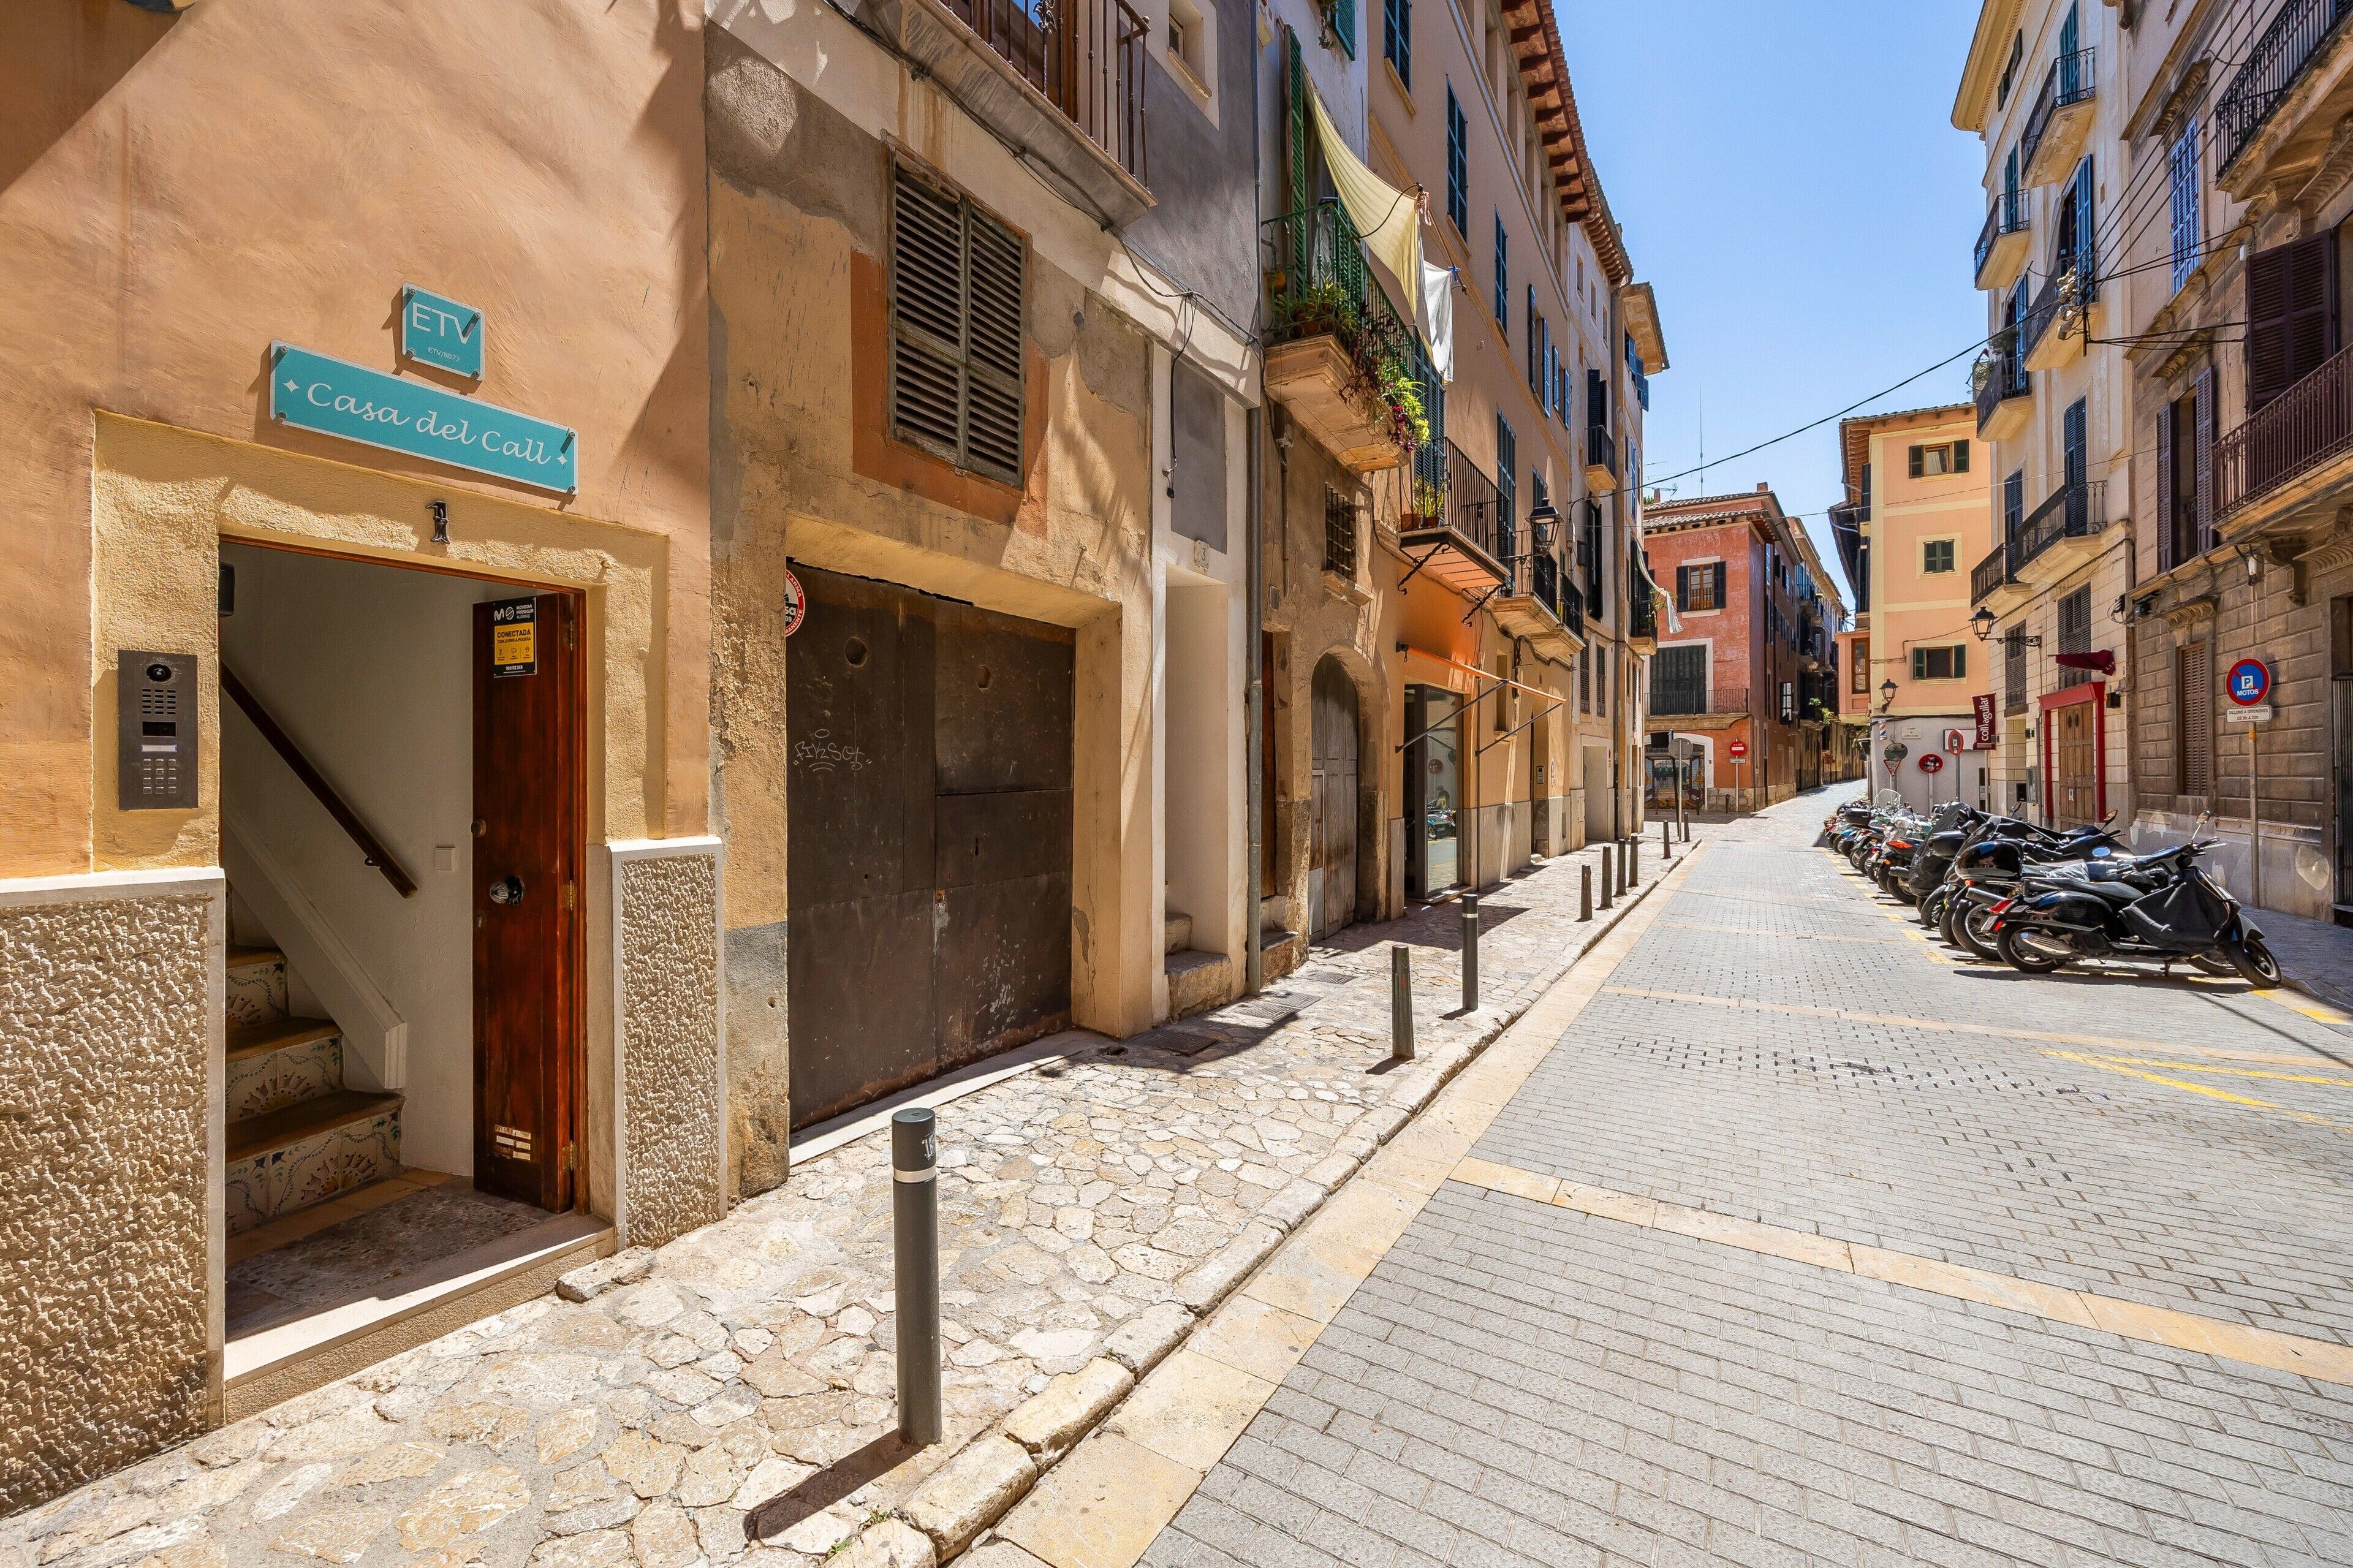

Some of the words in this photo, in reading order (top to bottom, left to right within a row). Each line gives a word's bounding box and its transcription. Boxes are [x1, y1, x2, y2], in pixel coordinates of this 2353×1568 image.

[412, 302, 476, 344] ETV
[307, 382, 411, 427] Casa
[415, 409, 477, 445] del
[482, 430, 552, 466] Call
[425, 500, 450, 545] 1
[497, 629, 531, 638] CONECTADA
[2244, 678, 2251, 687] P
